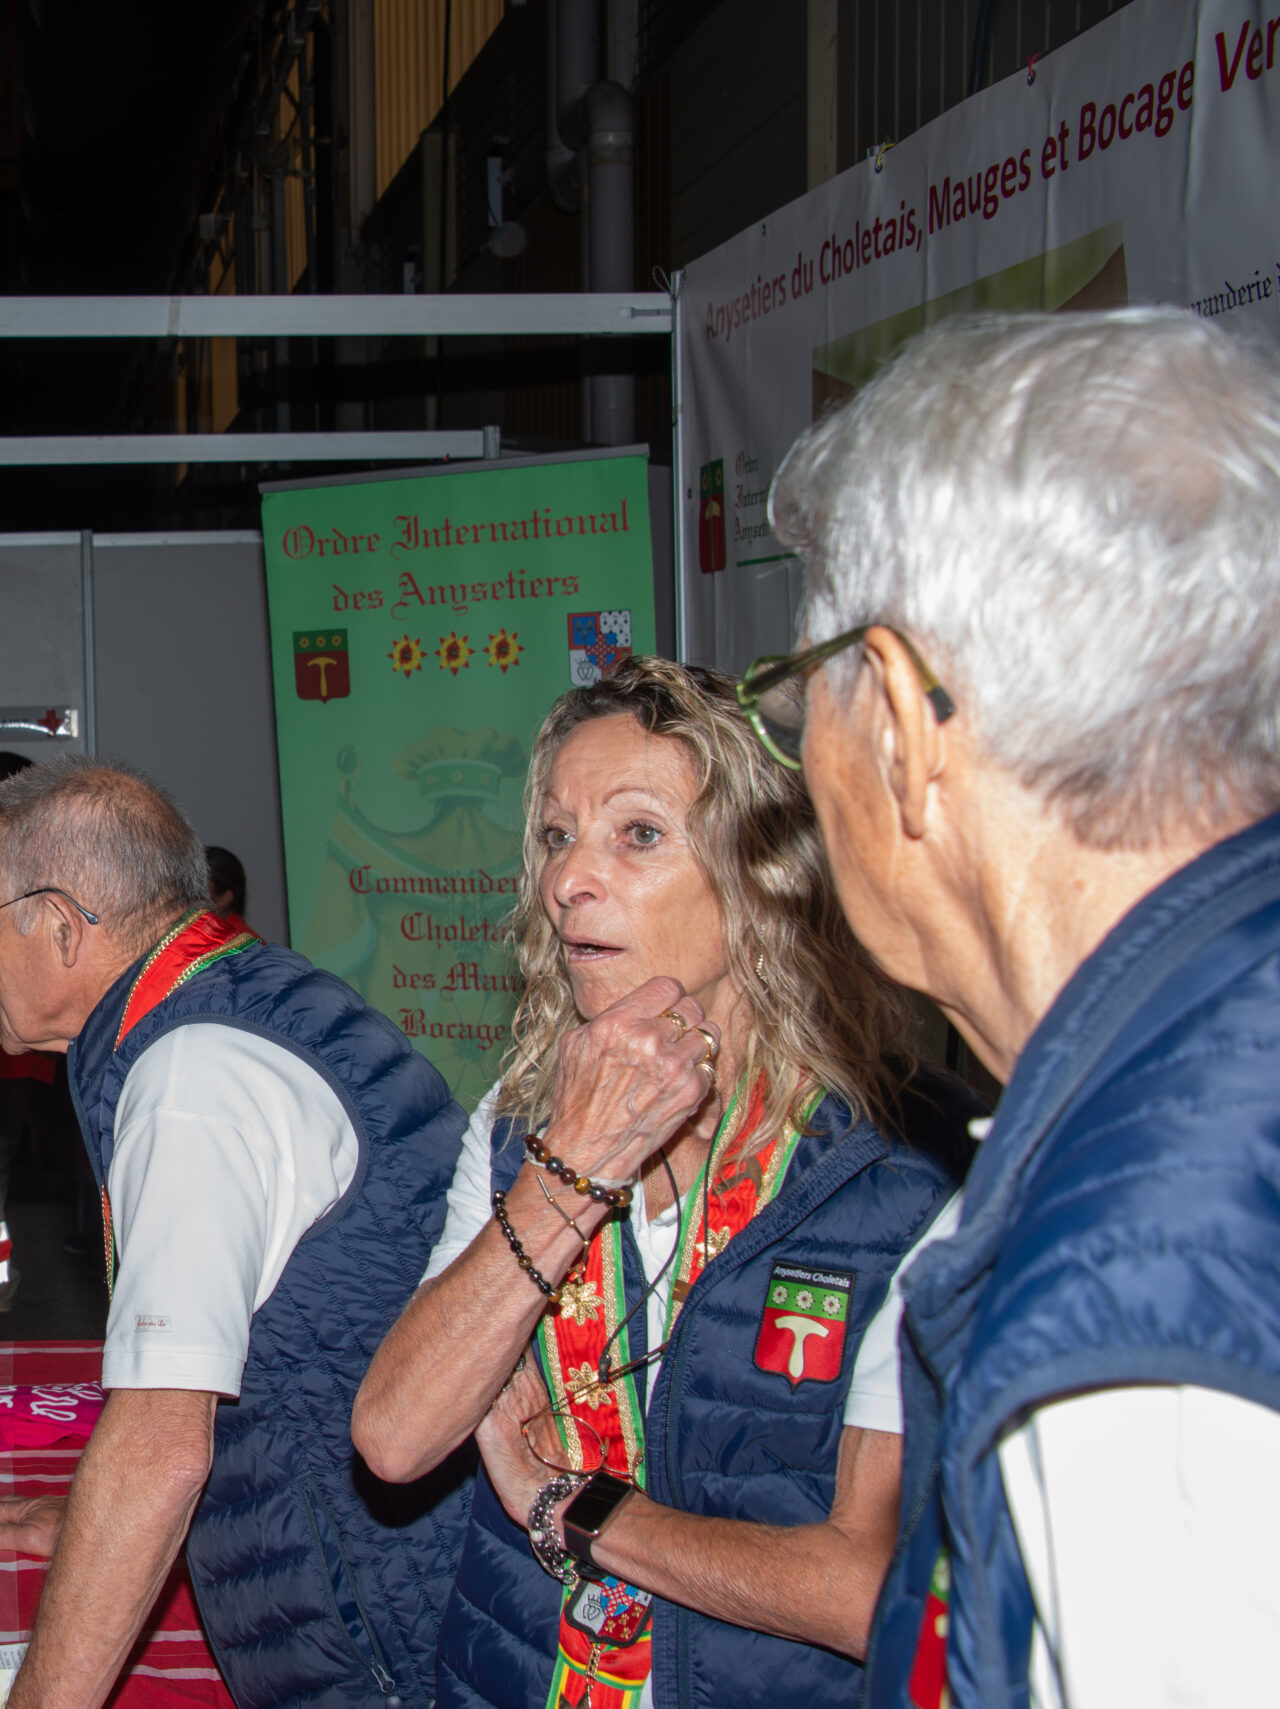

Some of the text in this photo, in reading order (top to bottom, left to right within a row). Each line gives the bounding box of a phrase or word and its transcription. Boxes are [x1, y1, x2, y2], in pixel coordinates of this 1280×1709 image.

[706, 274, 787, 342] Anysetiers
[791, 252, 814, 300] du
[819, 200, 922, 286] Choletais,
[928, 148, 1032, 236] Mauges
[1040, 120, 1070, 180] et
[1078, 60, 1195, 163] Bocage
[282, 496, 631, 560] Ordre International
[332, 568, 581, 621] des Anysetiers
[391, 964, 436, 990] des
[397, 1007, 507, 1051] Bocage
[773, 1266, 851, 1289] Anysetiers Choletais
